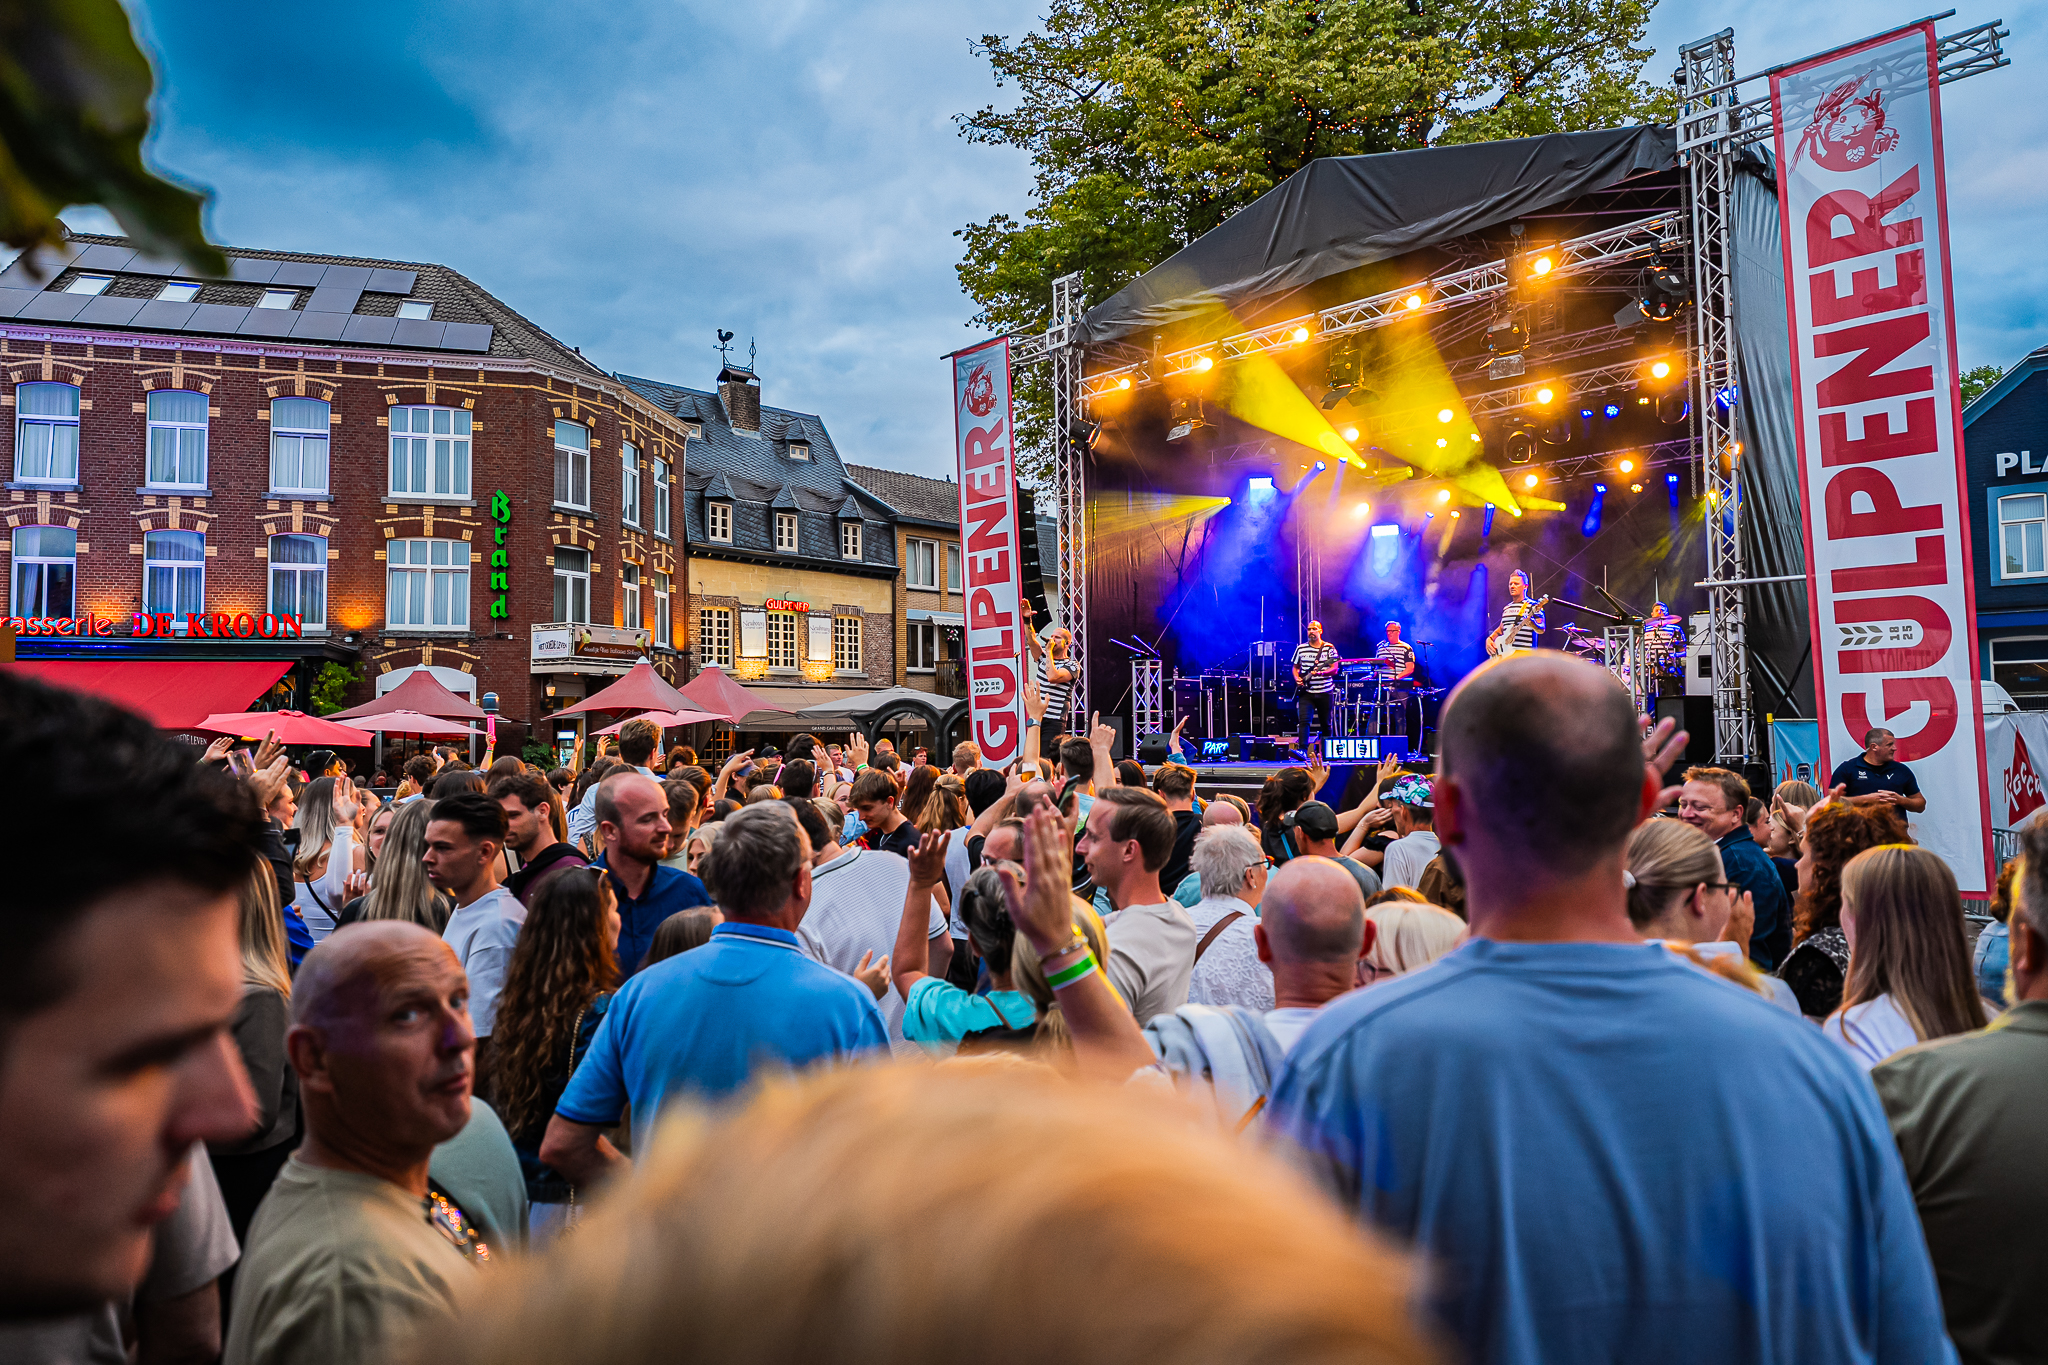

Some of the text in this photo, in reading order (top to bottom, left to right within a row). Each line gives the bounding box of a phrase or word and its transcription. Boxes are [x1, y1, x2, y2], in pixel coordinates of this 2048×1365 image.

[1806, 163, 1958, 762] GULPENER
[1996, 451, 2048, 477] PL
[490, 489, 511, 618] Brand
[965, 416, 1018, 761] GULPENER
[766, 598, 810, 613] GULPENER
[131, 613, 175, 637] DE
[185, 612, 303, 638] KROON
[191, 735, 208, 746] LEVEN
